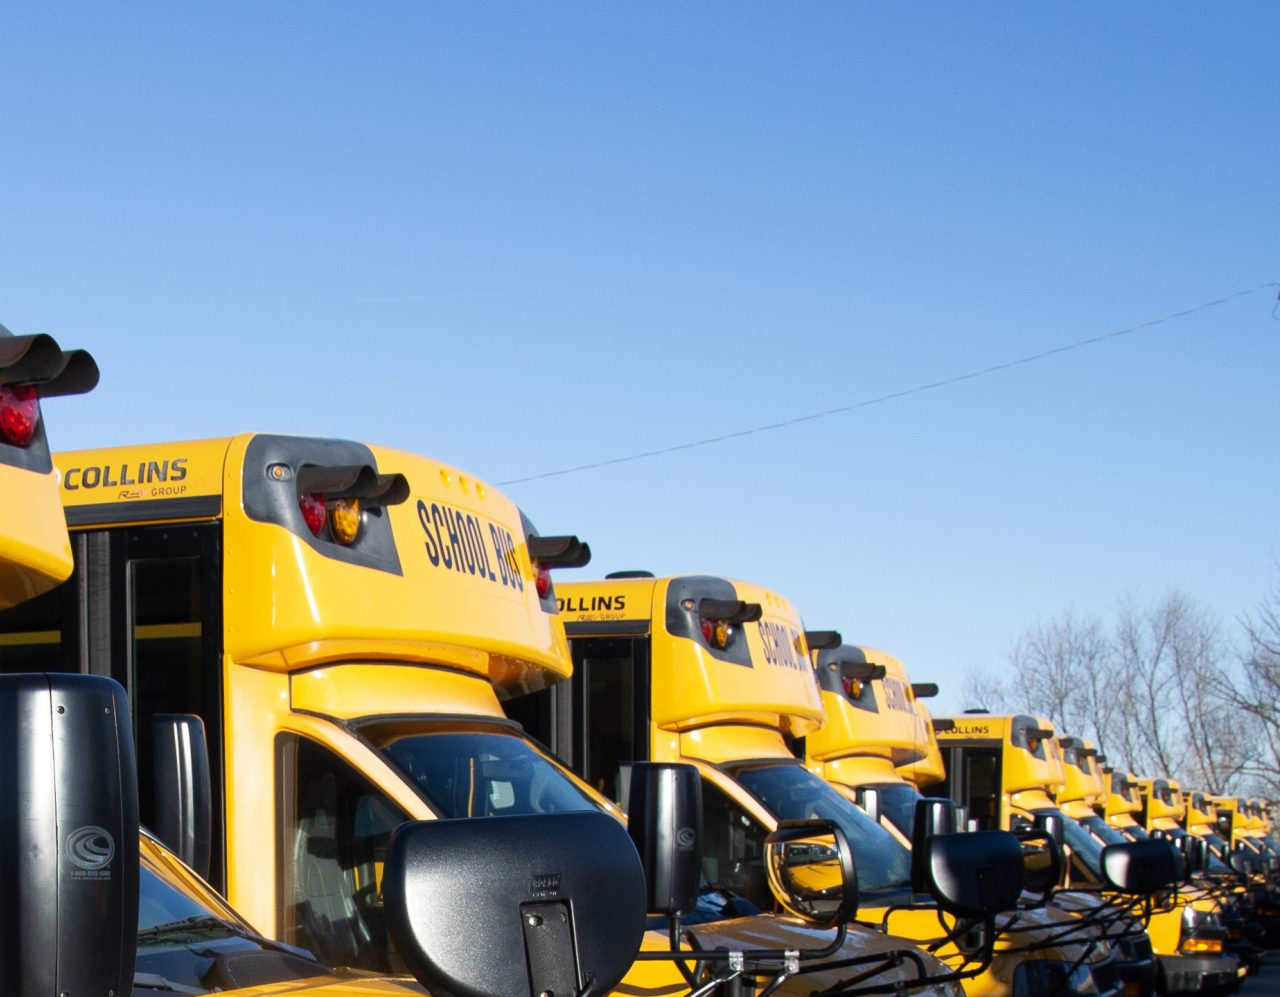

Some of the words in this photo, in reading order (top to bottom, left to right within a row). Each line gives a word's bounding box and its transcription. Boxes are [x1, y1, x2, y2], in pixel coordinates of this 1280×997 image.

[64, 458, 188, 490] COLLINS
[151, 486, 187, 497] GROUP
[417, 499, 497, 582] SCHOOL
[487, 522, 524, 593] BUS
[556, 595, 625, 612] OLLINS
